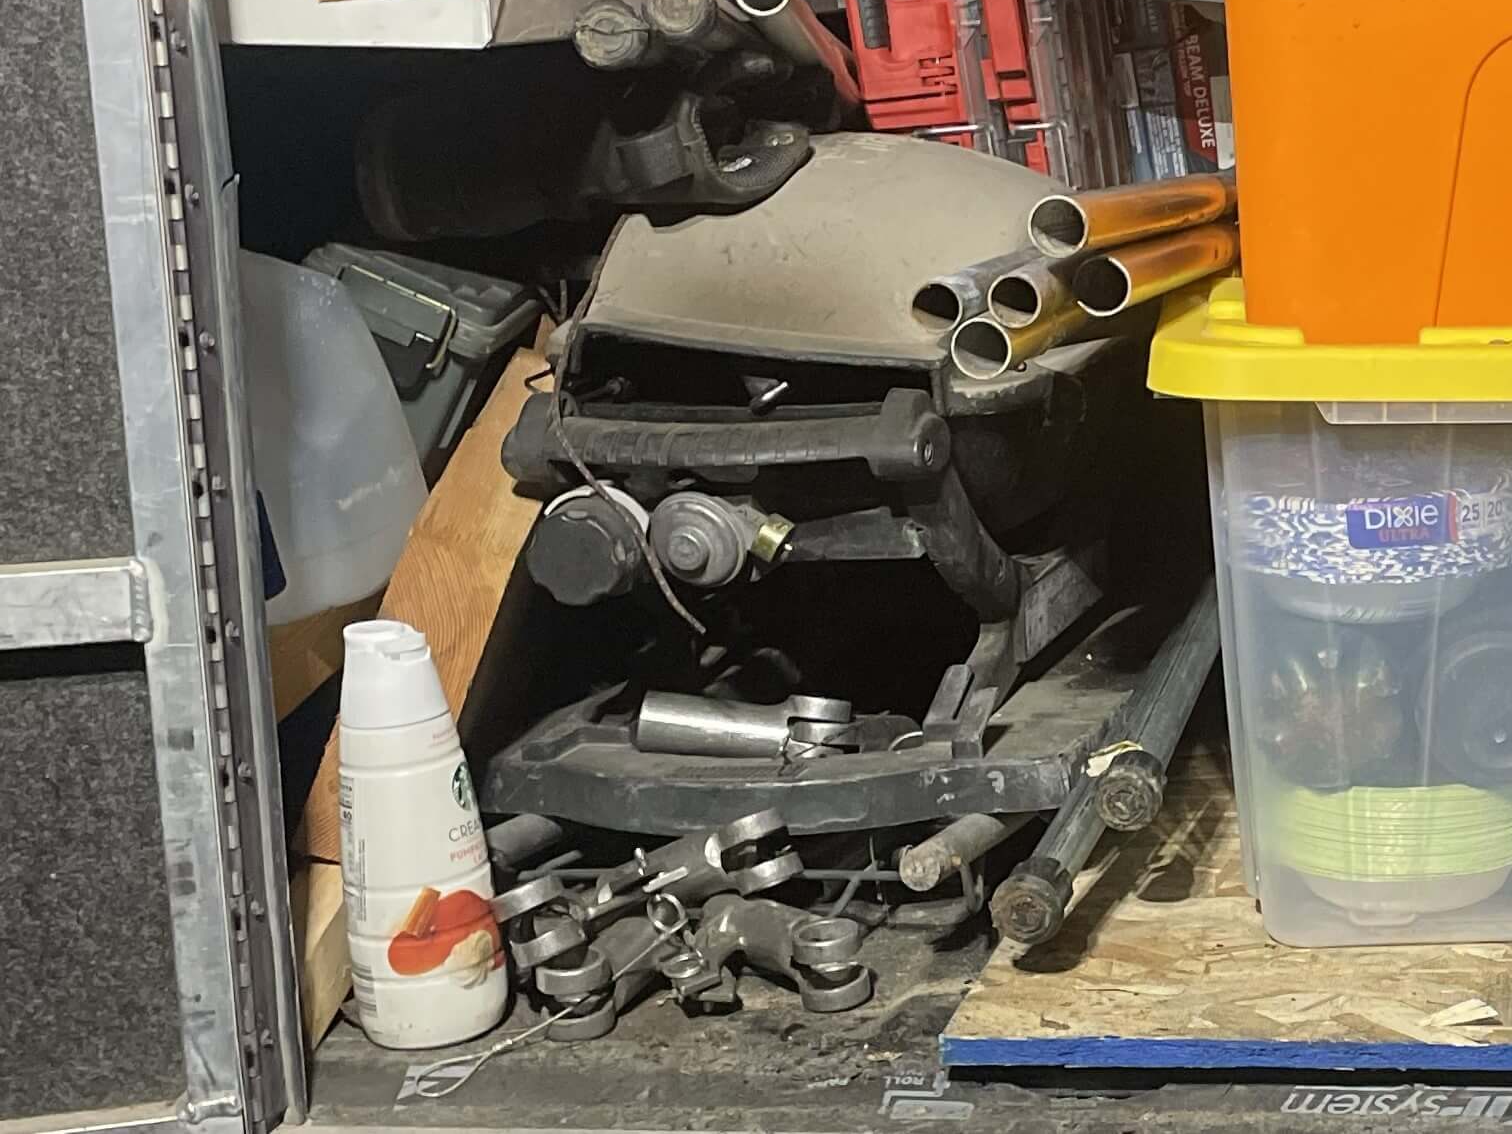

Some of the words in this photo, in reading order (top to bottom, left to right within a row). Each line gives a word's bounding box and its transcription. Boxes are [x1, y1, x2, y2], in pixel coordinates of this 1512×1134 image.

[1193, 86, 1216, 148] DELUXE
[1461, 504, 1480, 523] 25
[1377, 528, 1432, 544] ULTRA
[883, 1075, 926, 1089] ROLL
